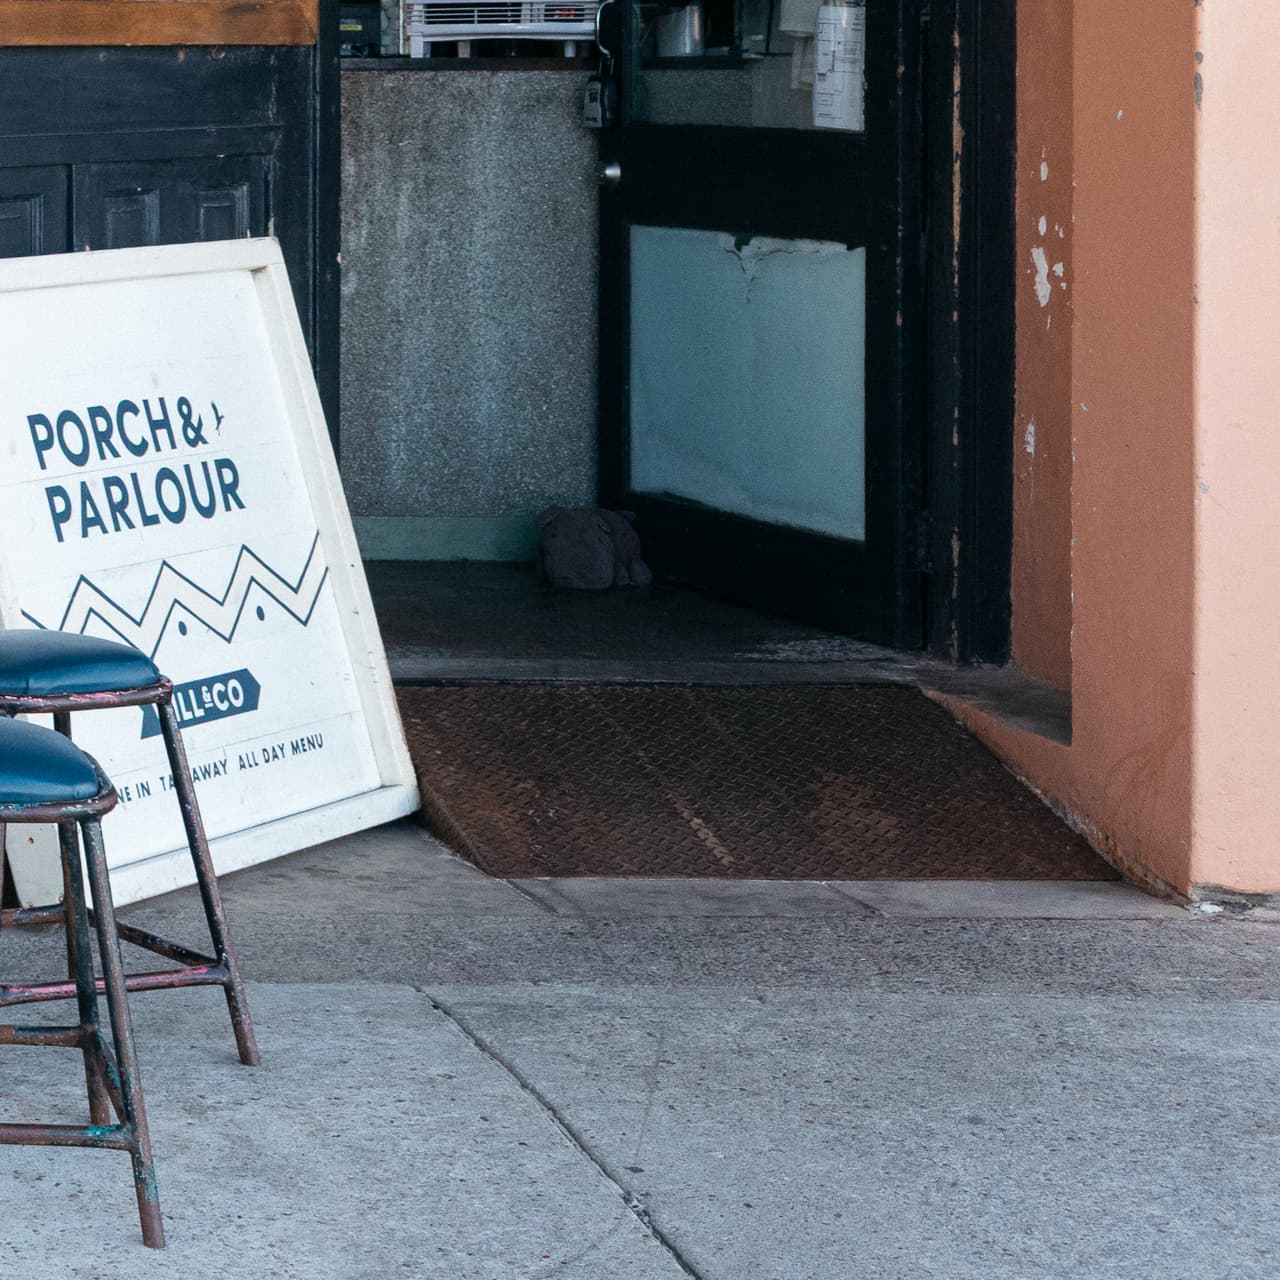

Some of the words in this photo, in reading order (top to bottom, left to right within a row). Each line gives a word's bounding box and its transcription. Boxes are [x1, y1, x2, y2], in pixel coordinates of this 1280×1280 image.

[26, 396, 208, 470] PORCH&
[45, 458, 246, 543] PARLOUR
[152, 678, 244, 722] ILL&CO
[135, 781, 151, 799] IN
[239, 751, 260, 770] ALL
[262, 742, 286, 763] DAY
[290, 733, 324, 757] MENU
